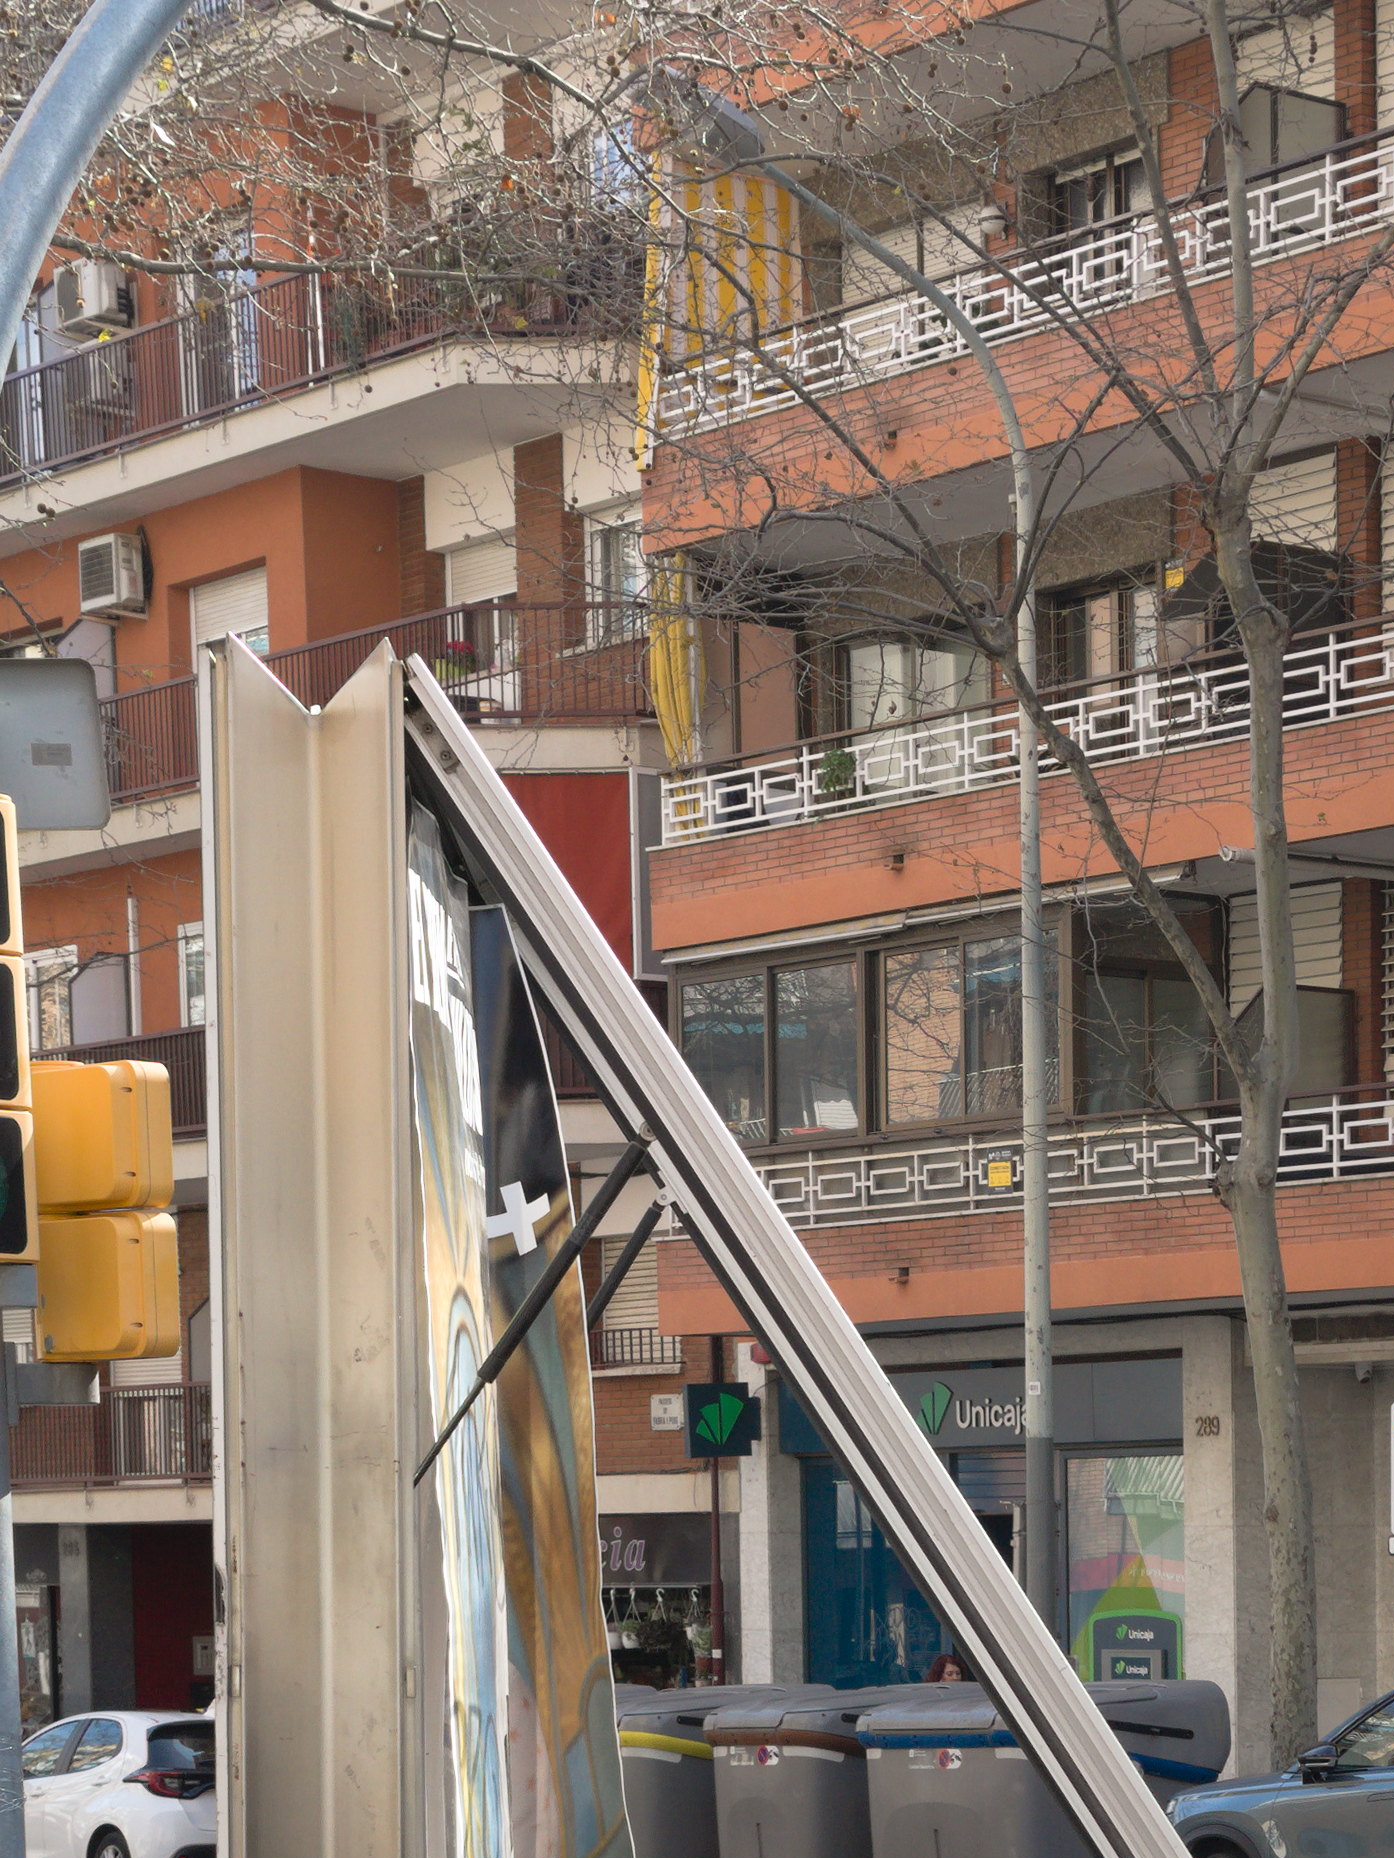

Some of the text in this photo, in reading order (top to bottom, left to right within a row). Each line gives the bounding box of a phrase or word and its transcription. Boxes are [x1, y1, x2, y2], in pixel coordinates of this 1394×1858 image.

[1195, 1415, 1220, 1437] 289
[1128, 1628, 1154, 1641] Unicaja
[1126, 1664, 1149, 1676] Unicaja
